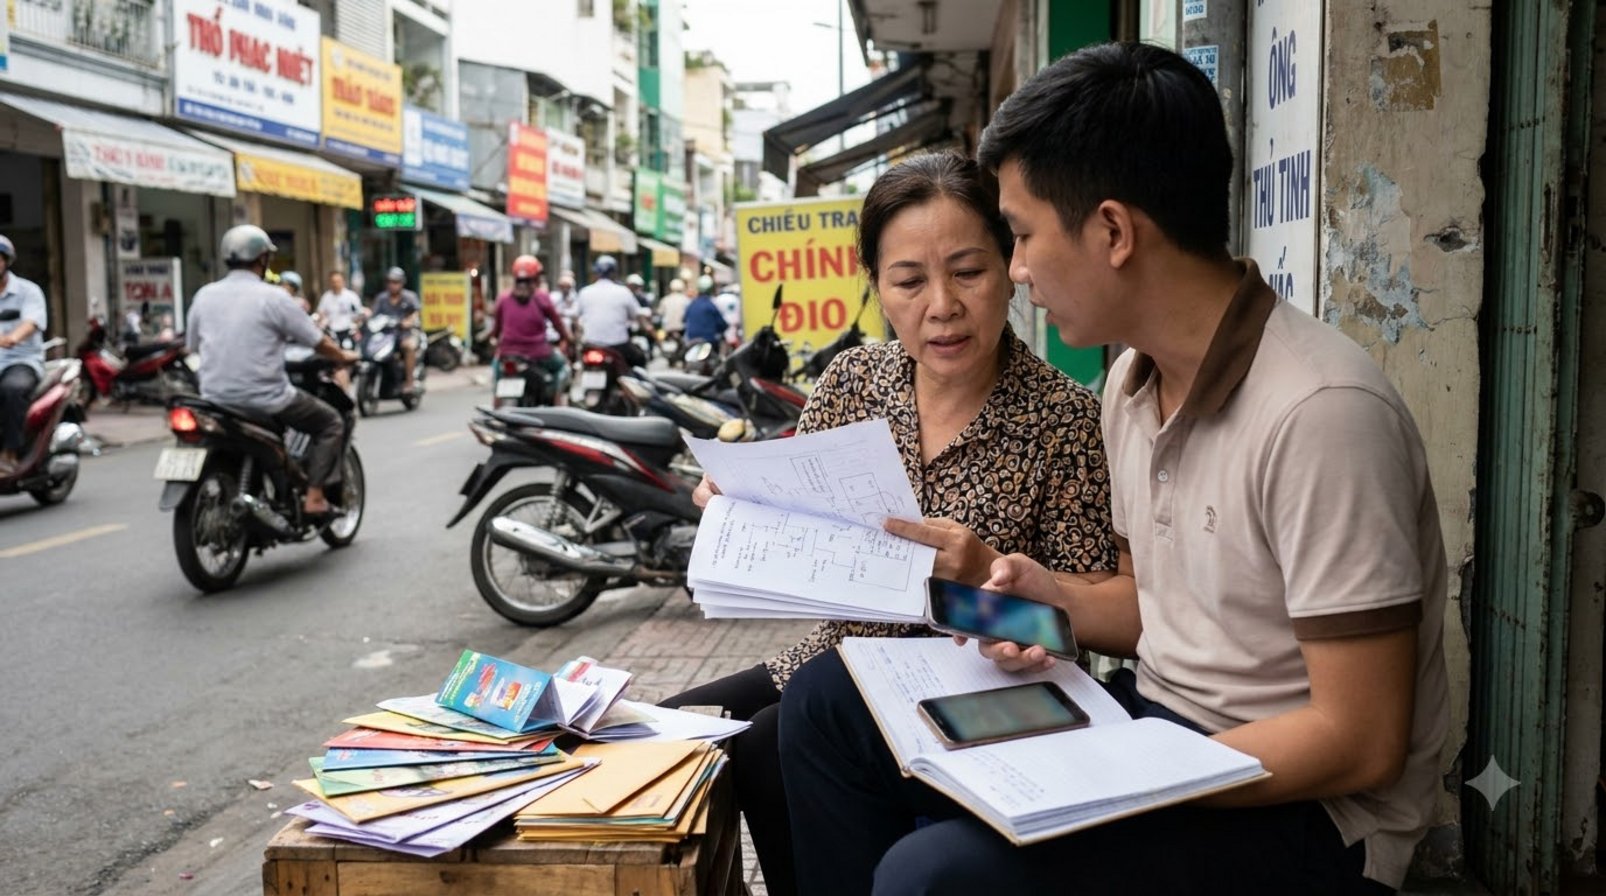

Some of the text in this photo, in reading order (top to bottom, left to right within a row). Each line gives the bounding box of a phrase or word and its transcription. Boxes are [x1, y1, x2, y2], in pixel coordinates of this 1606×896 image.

[1269, 26, 1296, 110] ÔNG
[1279, 149, 1311, 224] TINH
[780, 298, 847, 332] ĐIO
